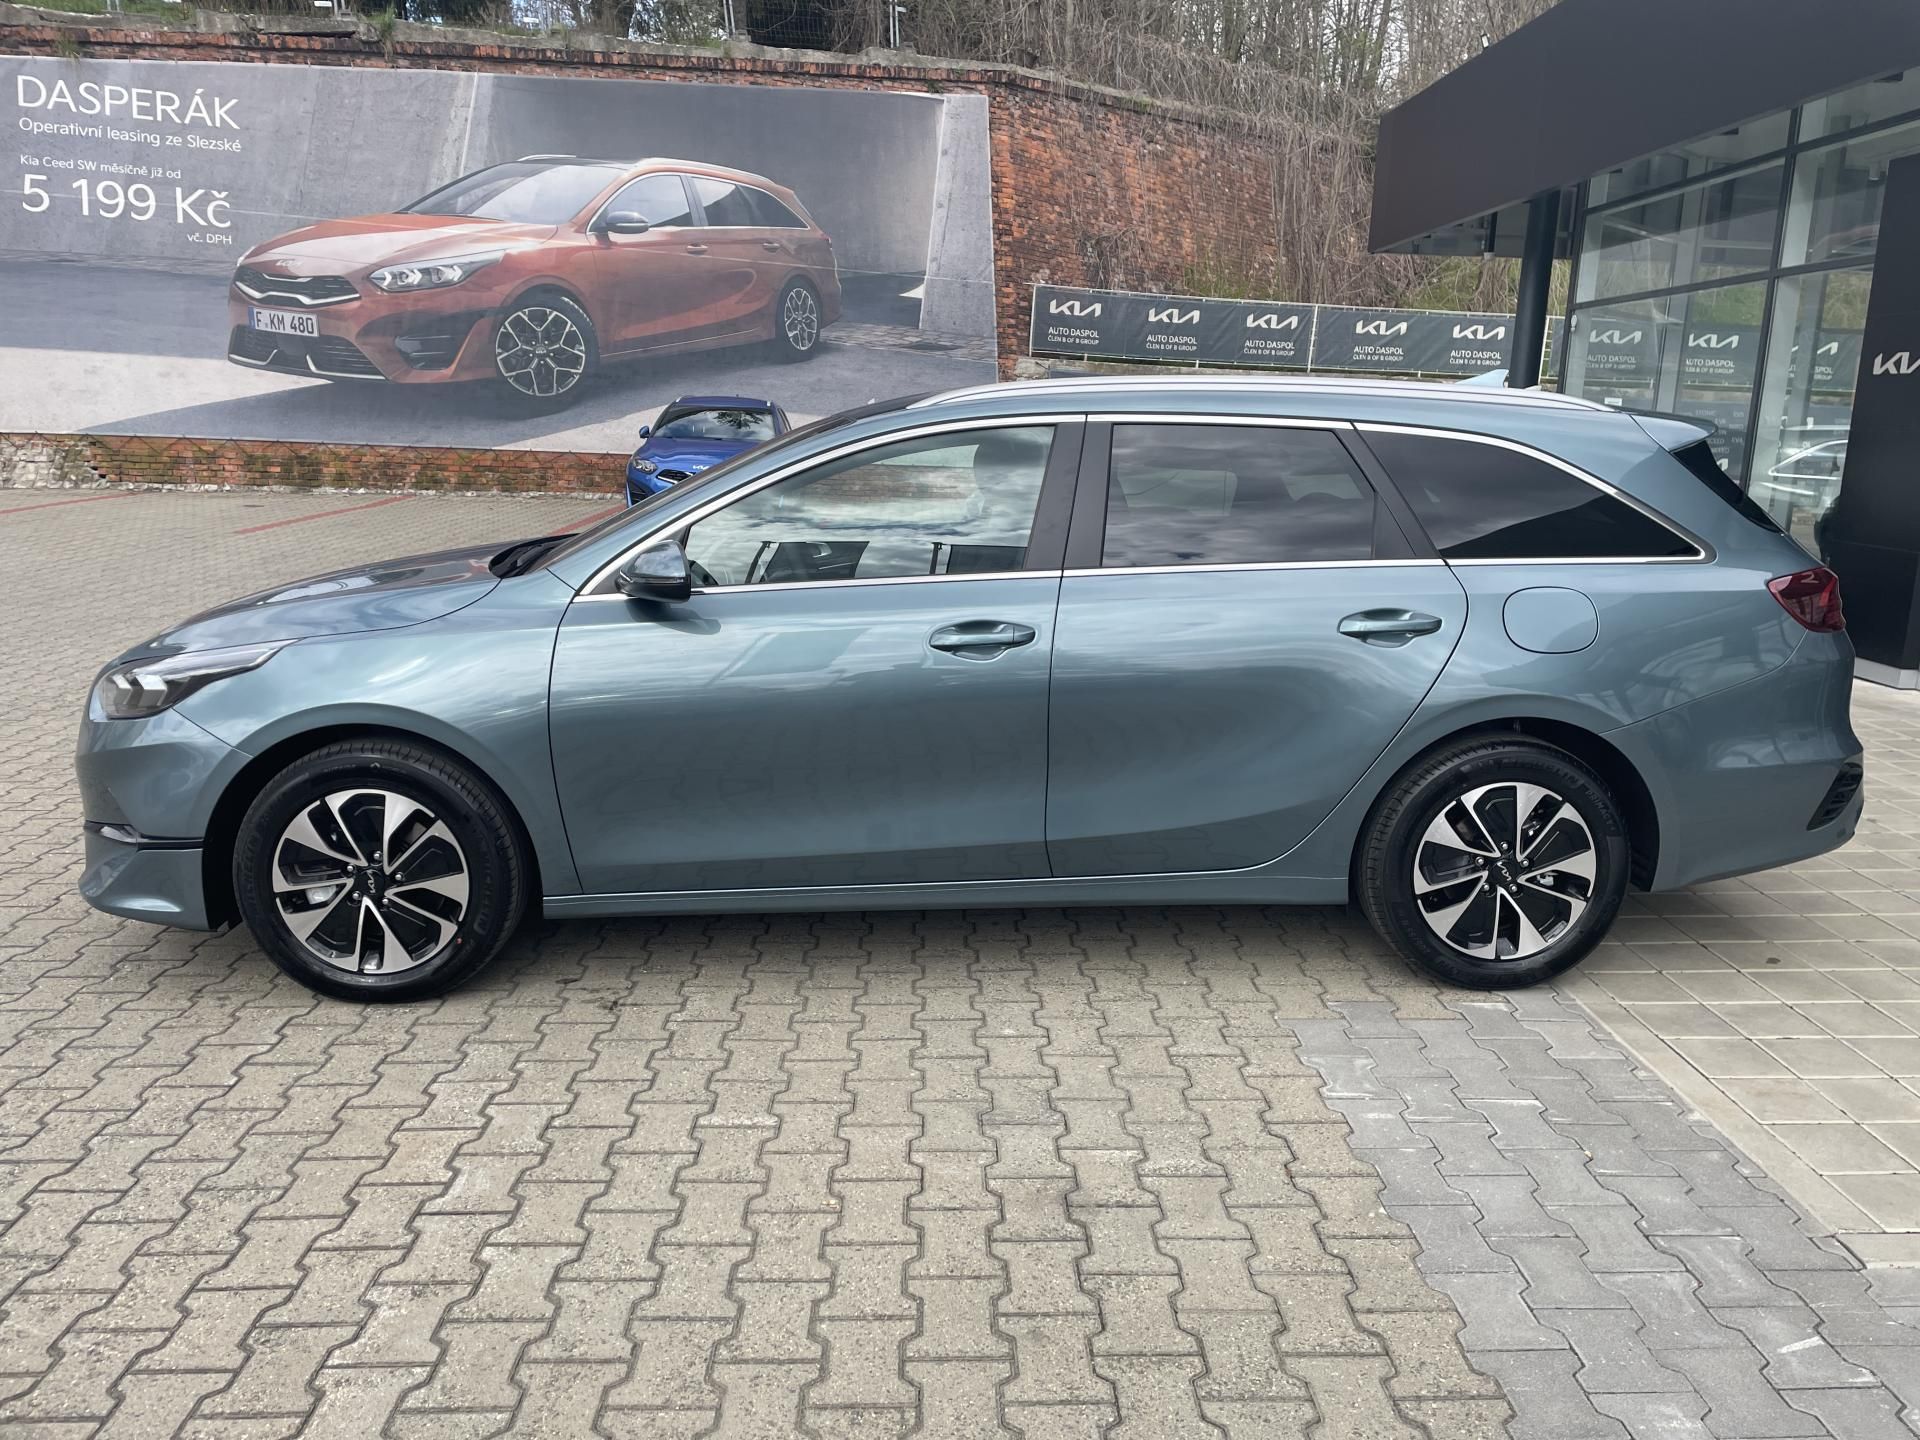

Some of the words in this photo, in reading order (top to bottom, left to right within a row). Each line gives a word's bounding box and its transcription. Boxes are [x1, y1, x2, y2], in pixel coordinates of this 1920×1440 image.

[17, 74, 240, 129] DASPERÁK
[19, 117, 102, 138] Operativní
[107, 126, 161, 147] leasing
[165, 135, 183, 146] ze
[187, 135, 241, 152] Slezské
[20, 155, 39, 166] Kia
[43, 157, 74, 169] Ceed
[77, 159, 97, 171] SW
[100, 162, 148, 176] měsíčně
[149, 167, 163, 179] již
[166, 169, 181, 179] od
[22, 174, 50, 212] 5
[72, 178, 157, 221] 199
[175, 187, 231, 228] Kč
[187, 232, 204, 243] vč.
[206, 233, 232, 245] DPH
[1049, 298, 1102, 318] KIA
[1148, 307, 1201, 325] KIA
[289, 315, 315, 335] 480
[1246, 313, 1299, 330] KIA
[1355, 319, 1408, 336] KIA
[1048, 326, 1069, 336] AUTO
[1070, 328, 1100, 339] DASPOL
[1146, 334, 1168, 343] AUTO
[1168, 335, 1198, 345] DASPOL
[1452, 324, 1506, 341] KIA
[1589, 328, 1643, 345] KIA
[1687, 332, 1740, 350] KIA
[1244, 339, 1265, 348] AUTO
[1266, 341, 1296, 350] DASPOL
[1353, 345, 1375, 354] AUTO
[1375, 346, 1405, 356] DASPOL
[1450, 350, 1472, 358] AUTO
[1472, 350, 1502, 360] DASPOL
